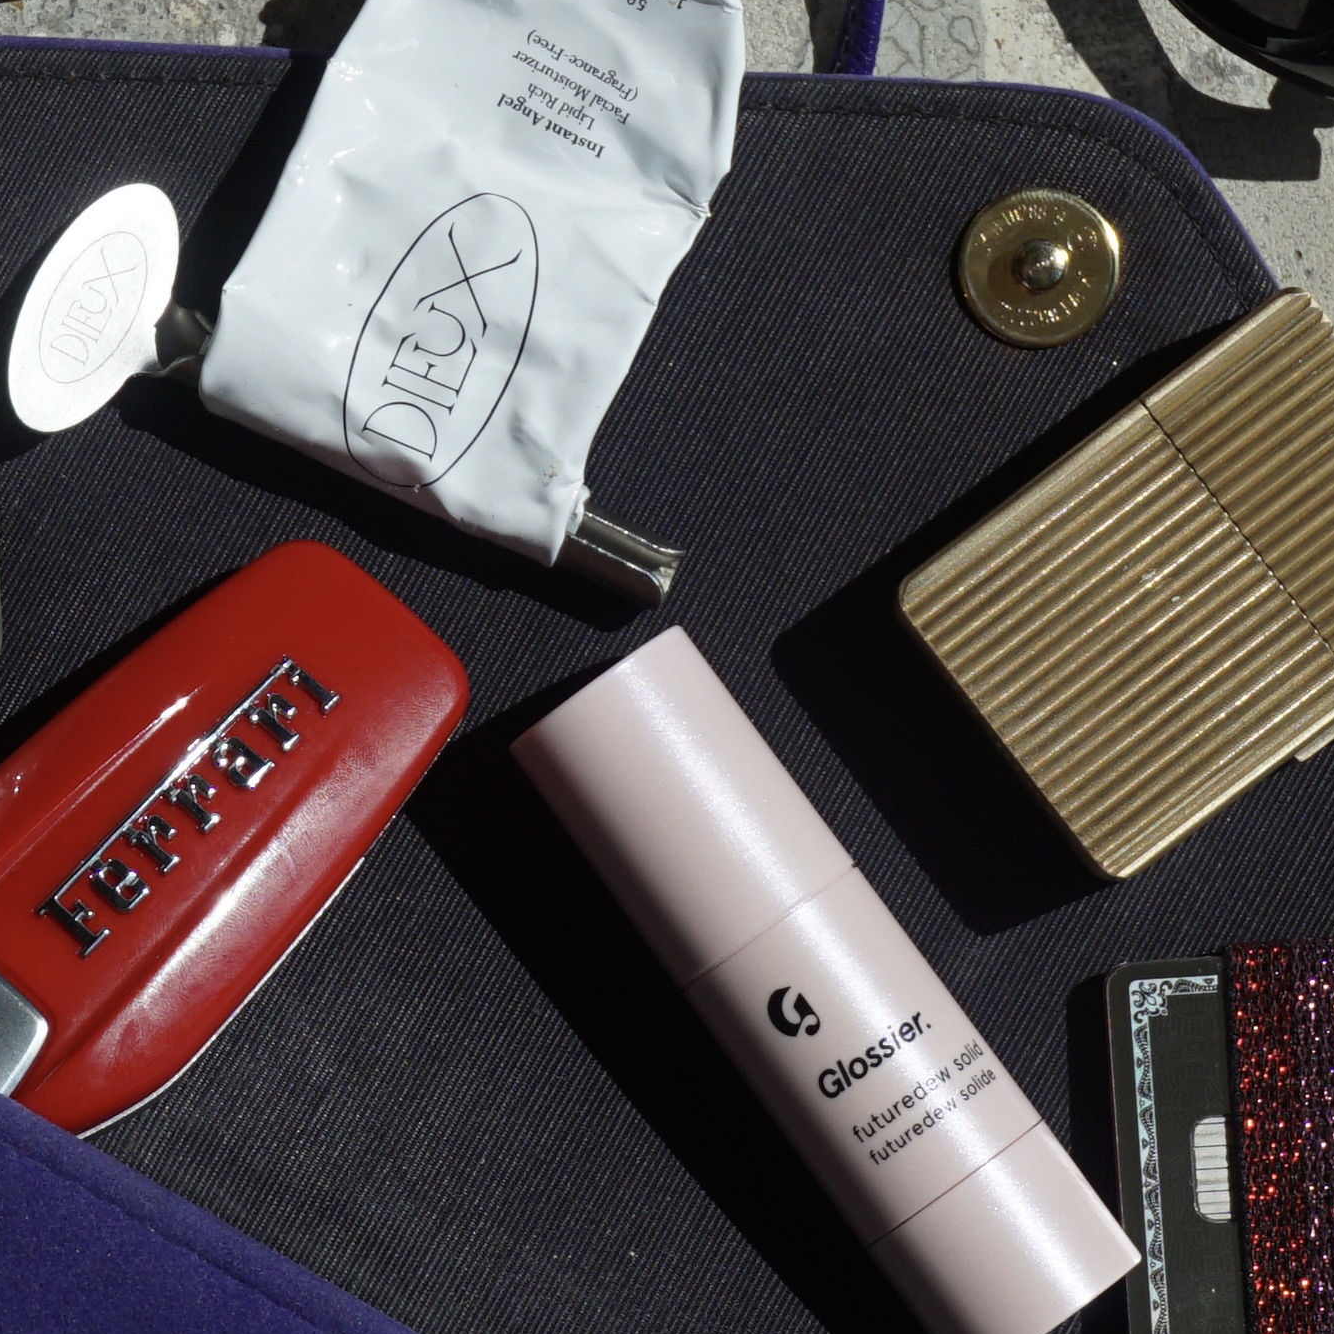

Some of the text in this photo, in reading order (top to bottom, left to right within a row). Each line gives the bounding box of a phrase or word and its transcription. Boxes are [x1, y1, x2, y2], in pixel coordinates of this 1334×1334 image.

[512, 50, 631, 125] Facial Moisturizer
[527, 29, 638, 102] (Fragrance-Free)
[528, 82, 596, 131] Lipid Rich
[497, 93, 605, 158] Instant Angel
[50, 246, 138, 365] DIEUX
[362, 222, 523, 461] DIEUX
[33, 654, 341, 959] Ferrari
[818, 1010, 931, 1099] Glossier.
[853, 1039, 984, 1143] futuredew solid
[869, 1067, 996, 1165] futuredew solide
